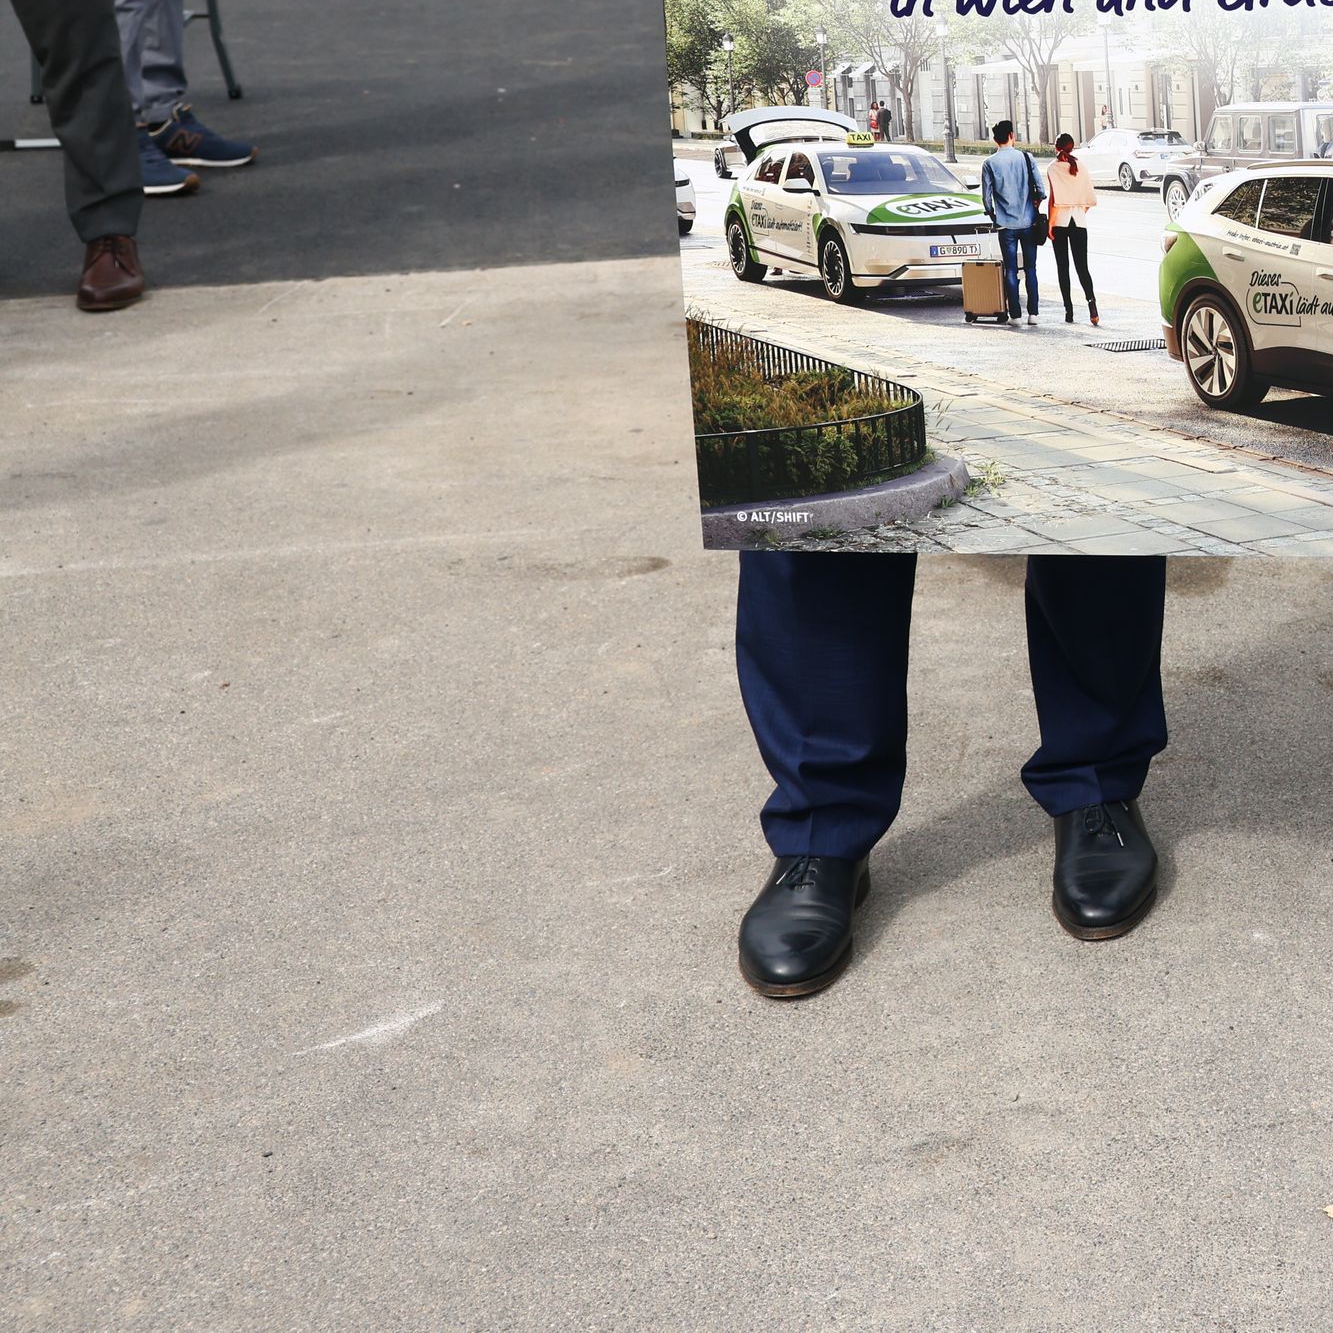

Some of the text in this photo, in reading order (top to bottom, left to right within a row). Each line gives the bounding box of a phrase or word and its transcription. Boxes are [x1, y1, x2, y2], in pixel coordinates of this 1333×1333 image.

[851, 133, 872, 142] TAXI
[952, 246, 968, 254] 890
[1249, 269, 1282, 287] Dieses
[1295, 294, 1320, 315] lädt
[750, 510, 809, 524] ALT/SHIFT
